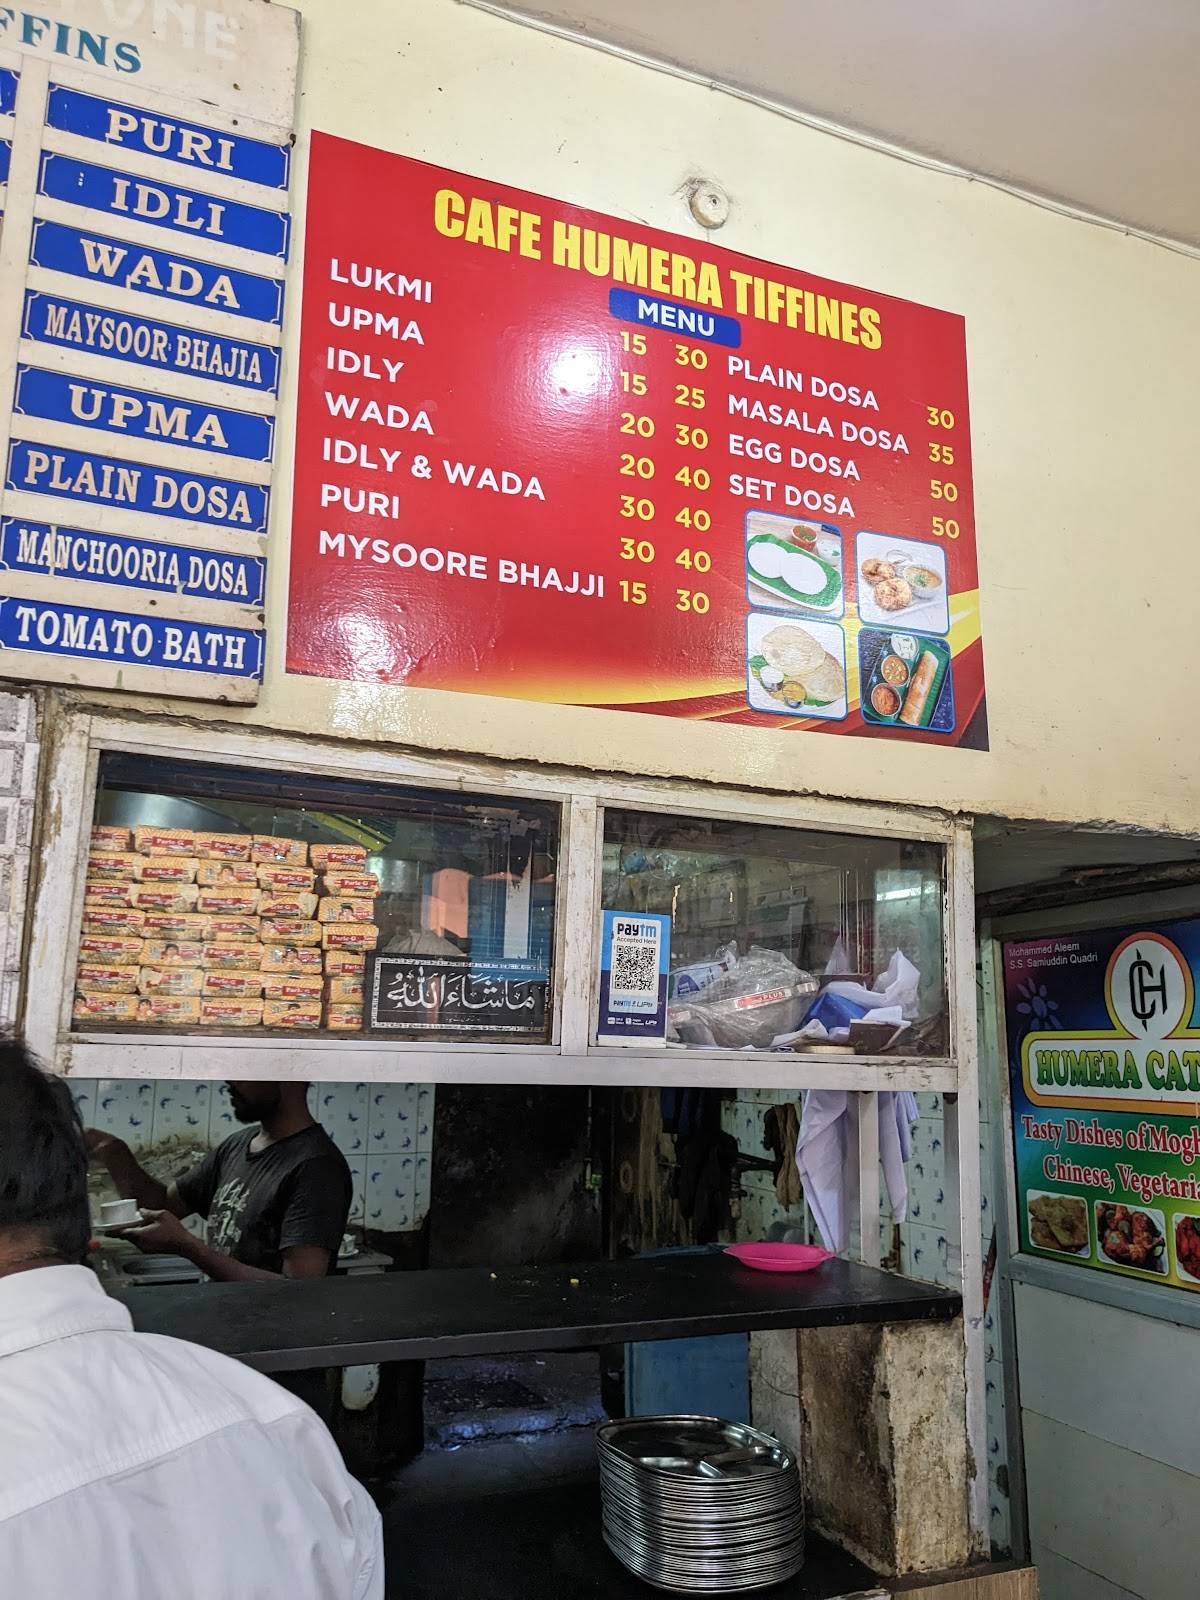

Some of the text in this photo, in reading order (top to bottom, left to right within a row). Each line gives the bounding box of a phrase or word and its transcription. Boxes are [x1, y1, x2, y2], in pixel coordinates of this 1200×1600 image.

[104, 108, 235, 171] PURI
[110, 177, 226, 236] IDLI
[80, 237, 241, 309] WADA
[330, 258, 432, 303] LUKMI
[434, 189, 882, 351] CAFE HUMERA TIFFINES
[328, 302, 425, 345] UPMA
[638, 299, 715, 337] MENU
[44, 303, 264, 384] MAYSOOR BHAJIA
[619, 331, 708, 370] 15 30
[326, 347, 405, 383] IDLY
[727, 355, 880, 411] PLAIN DOSA
[619, 371, 706, 409] 15 25
[68, 384, 229, 448] UPMA
[324, 391, 434, 435] WADA
[619, 413, 709, 450] 20 30
[728, 395, 910, 455] MASALA DOSA
[927, 406, 956, 429] 30
[323, 437, 546, 501] IDLY & WADA
[619, 453, 711, 491] 20 40
[729, 434, 861, 481] EGG DOSA
[928, 442, 955, 465] 35
[24, 450, 253, 524] PLAIN DOSA
[320, 483, 399, 519] PURI
[729, 474, 856, 518] SET DOSA
[930, 480, 959, 503] 50
[619, 495, 711, 532] 30 40
[931, 516, 960, 539] 50
[16, 529, 248, 596] MANCHOORIA DOSA
[319, 530, 604, 598] MYSOORE BHAJJI
[619, 537, 711, 573] 30 40
[618, 580, 710, 614] 15 30
[15, 606, 247, 670] TOMATO BATH
[1008, 943, 1080, 957] Mohammed Aleem
[1027, 957, 1068, 968] Samiuddin
[1069, 952, 1098, 964] Quadri
[1035, 1049, 1142, 1090] HUMERA
[1022, 1116, 1062, 1148] Tasty
[1065, 1119, 1122, 1147] Dishes
[1127, 1122, 1146, 1149] of
[1044, 1155, 1116, 1194] Chinese,
